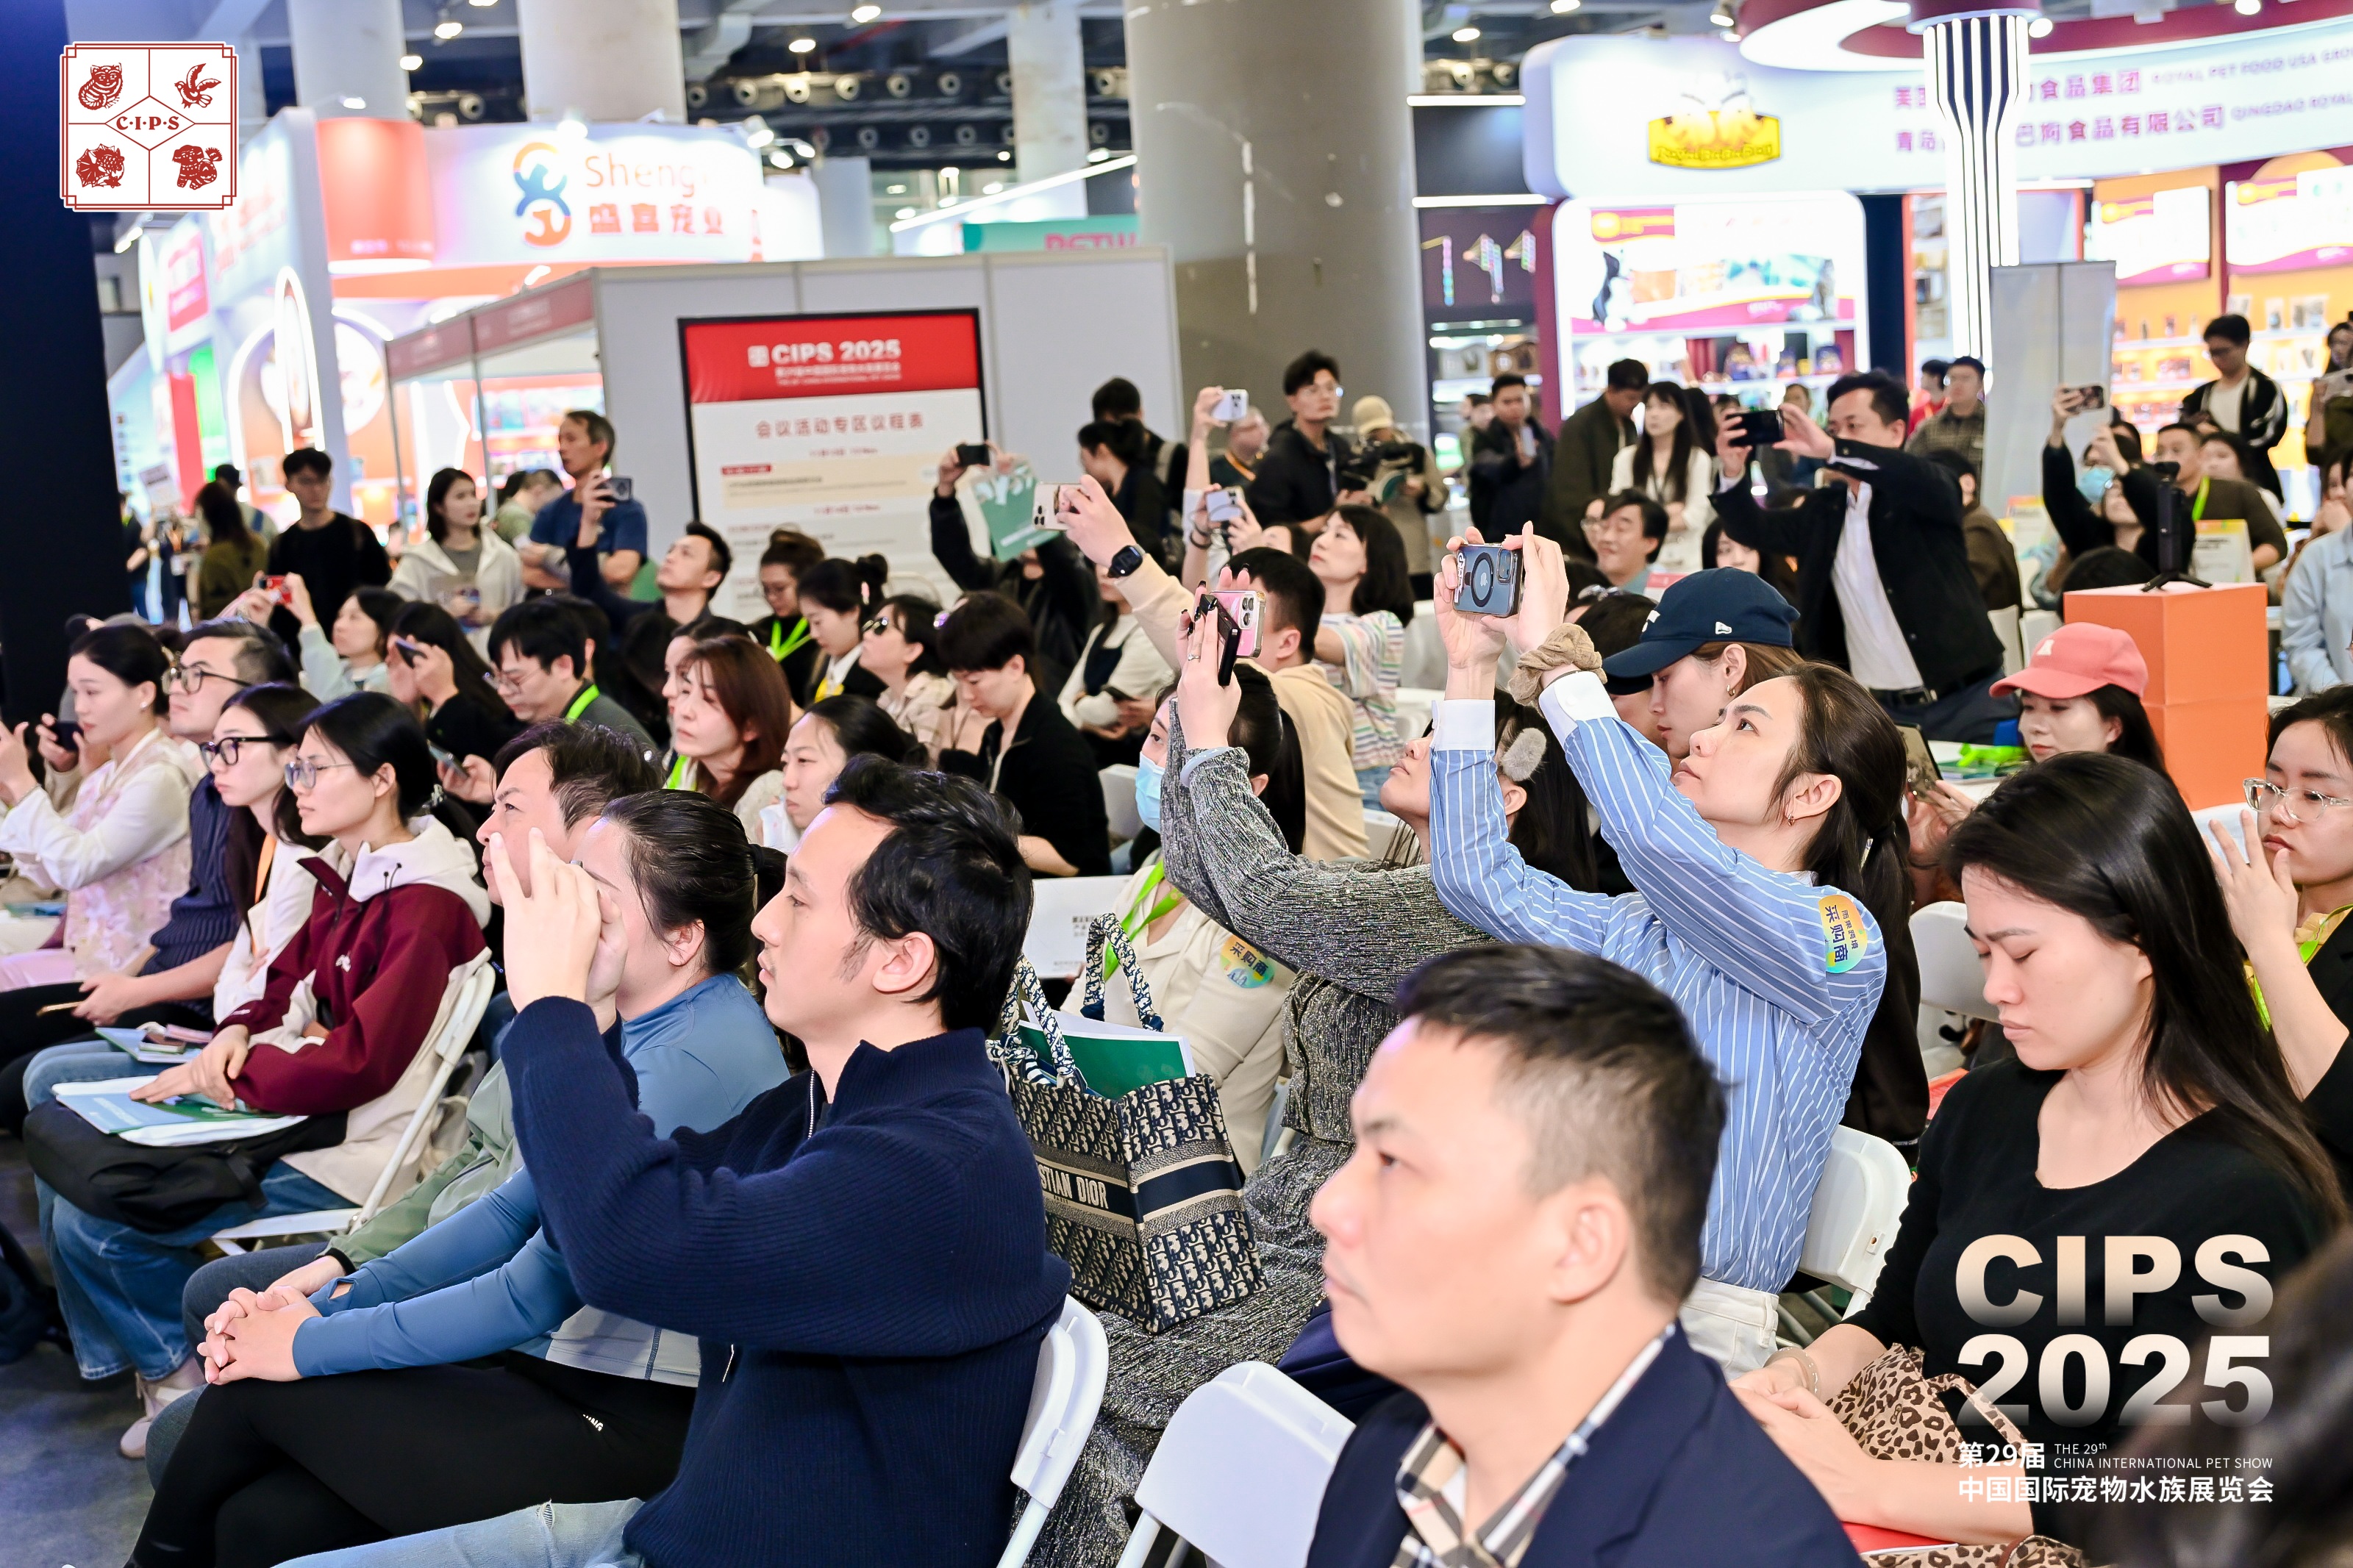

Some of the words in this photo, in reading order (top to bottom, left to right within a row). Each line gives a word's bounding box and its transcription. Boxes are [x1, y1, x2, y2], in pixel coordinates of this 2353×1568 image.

[772, 342, 834, 364] CIPS
[839, 339, 901, 361] 2025
[1825, 904, 1848, 962] 采购商
[1229, 942, 1268, 976] 采购商
[1036, 1163, 1072, 1198] STIAN
[1076, 1176, 1109, 1209] DIOR
